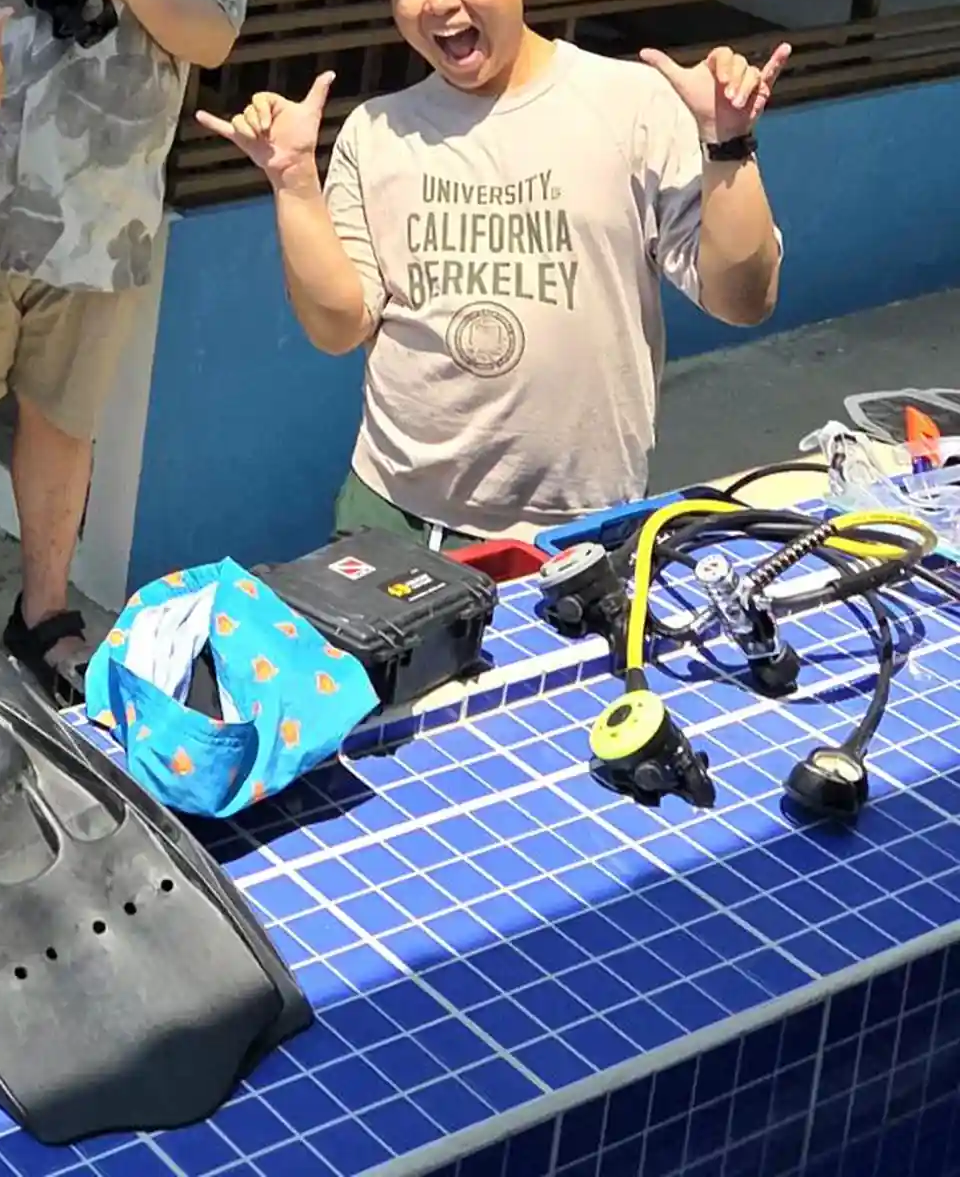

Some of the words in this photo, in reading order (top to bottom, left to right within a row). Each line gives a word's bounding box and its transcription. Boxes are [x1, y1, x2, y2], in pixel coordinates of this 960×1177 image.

[422, 169, 552, 206] UNIVERSITY
[406, 209, 574, 254] CALIFORNIA
[406, 260, 579, 311] BERKELEY
